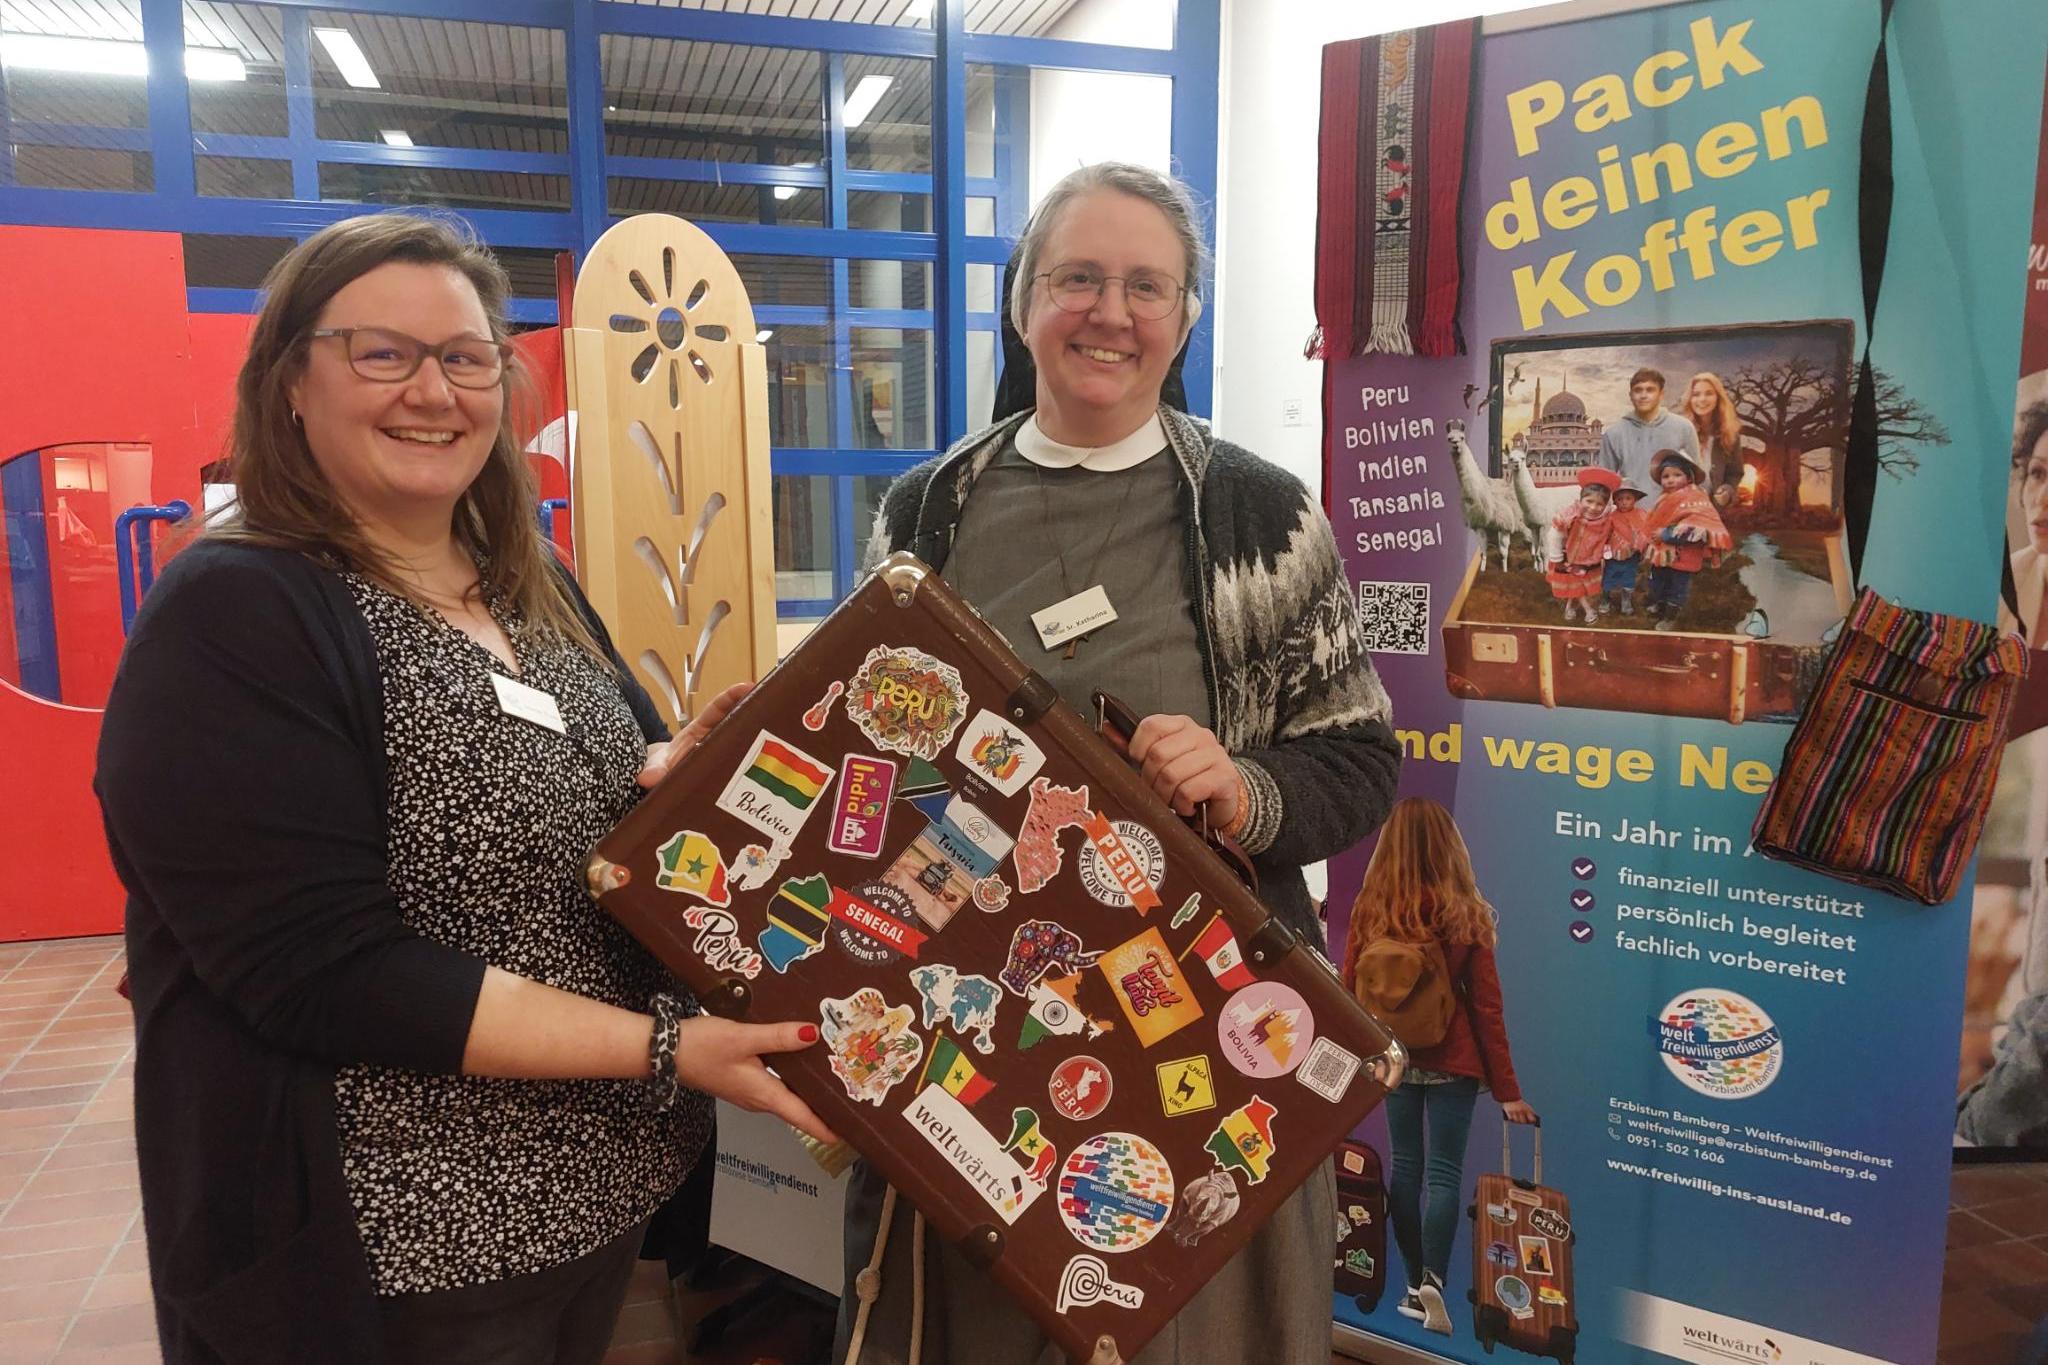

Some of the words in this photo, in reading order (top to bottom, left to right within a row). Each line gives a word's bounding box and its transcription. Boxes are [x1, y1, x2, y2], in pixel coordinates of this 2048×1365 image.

[1505, 16, 1765, 158] Pack
[1484, 95, 1829, 250] deinen
[1511, 187, 1831, 332] Koffer
[1361, 385, 1410, 411] Peru
[1345, 417, 1434, 449] Bolivien
[1358, 454, 1427, 483] Indien
[1349, 487, 1445, 519] Tansania
[1356, 522, 1442, 553] Senegal
[1395, 723, 1462, 763] nd
[1483, 736, 1655, 788] wage
[1679, 744, 1773, 795] Ne
[847, 764, 875, 813] India
[736, 791, 792, 836] Bolivia
[1555, 811, 1601, 839] Ein
[1612, 818, 1682, 849] Jahr
[1693, 827, 1731, 856] im
[1098, 833, 1146, 895] PERU
[1118, 823, 1162, 864] WELCOME
[1149, 868, 1161, 882] TO
[1081, 847, 1108, 901] WELCOME
[1111, 894, 1125, 905] TO
[1617, 867, 1719, 898] finanziell
[1727, 883, 1865, 919] unterstützt
[845, 903, 904, 943] SENEGAL
[863, 886, 906, 906] WELCOME
[902, 904, 912, 917] TO
[840, 928, 875, 960] WELCOME
[876, 950, 888, 959] TO
[1617, 901, 1734, 933] persönlich
[1742, 916, 1857, 953] begleitet
[1138, 950, 1183, 1008] Tamil
[1616, 931, 1701, 961] fachlich
[1708, 949, 1847, 986] vorbereitet
[1227, 1029, 1259, 1070] BOLIVIA
[1660, 1025, 1695, 1043] welt
[1661, 1031, 1779, 1060] freiwilligendienst
[1186, 1063, 1207, 1081] ALPACA
[1703, 1082, 1755, 1095] erzbistum
[1051, 1078, 1085, 1119] PERU
[1167, 1096, 1183, 1109] XING
[915, 1104, 1006, 1201] weltwärts
[1609, 1097, 1669, 1119] Erzbistum
[1673, 1111, 1730, 1135] Bamberg
[1744, 1126, 1894, 1168] Weltfreiwilligendienst
[1627, 1118, 1878, 1181] weltfreiwillige@erzbistum-bamberg.de
[1694, 1149, 1725, 1165] 1606
[1607, 1158, 1852, 1226] www.freiwillig-ins-ausland.de
[1534, 1215, 1563, 1236] PERU
[1060, 1258, 1136, 1309] Perú
[1683, 1326, 1769, 1358] weltwärts
